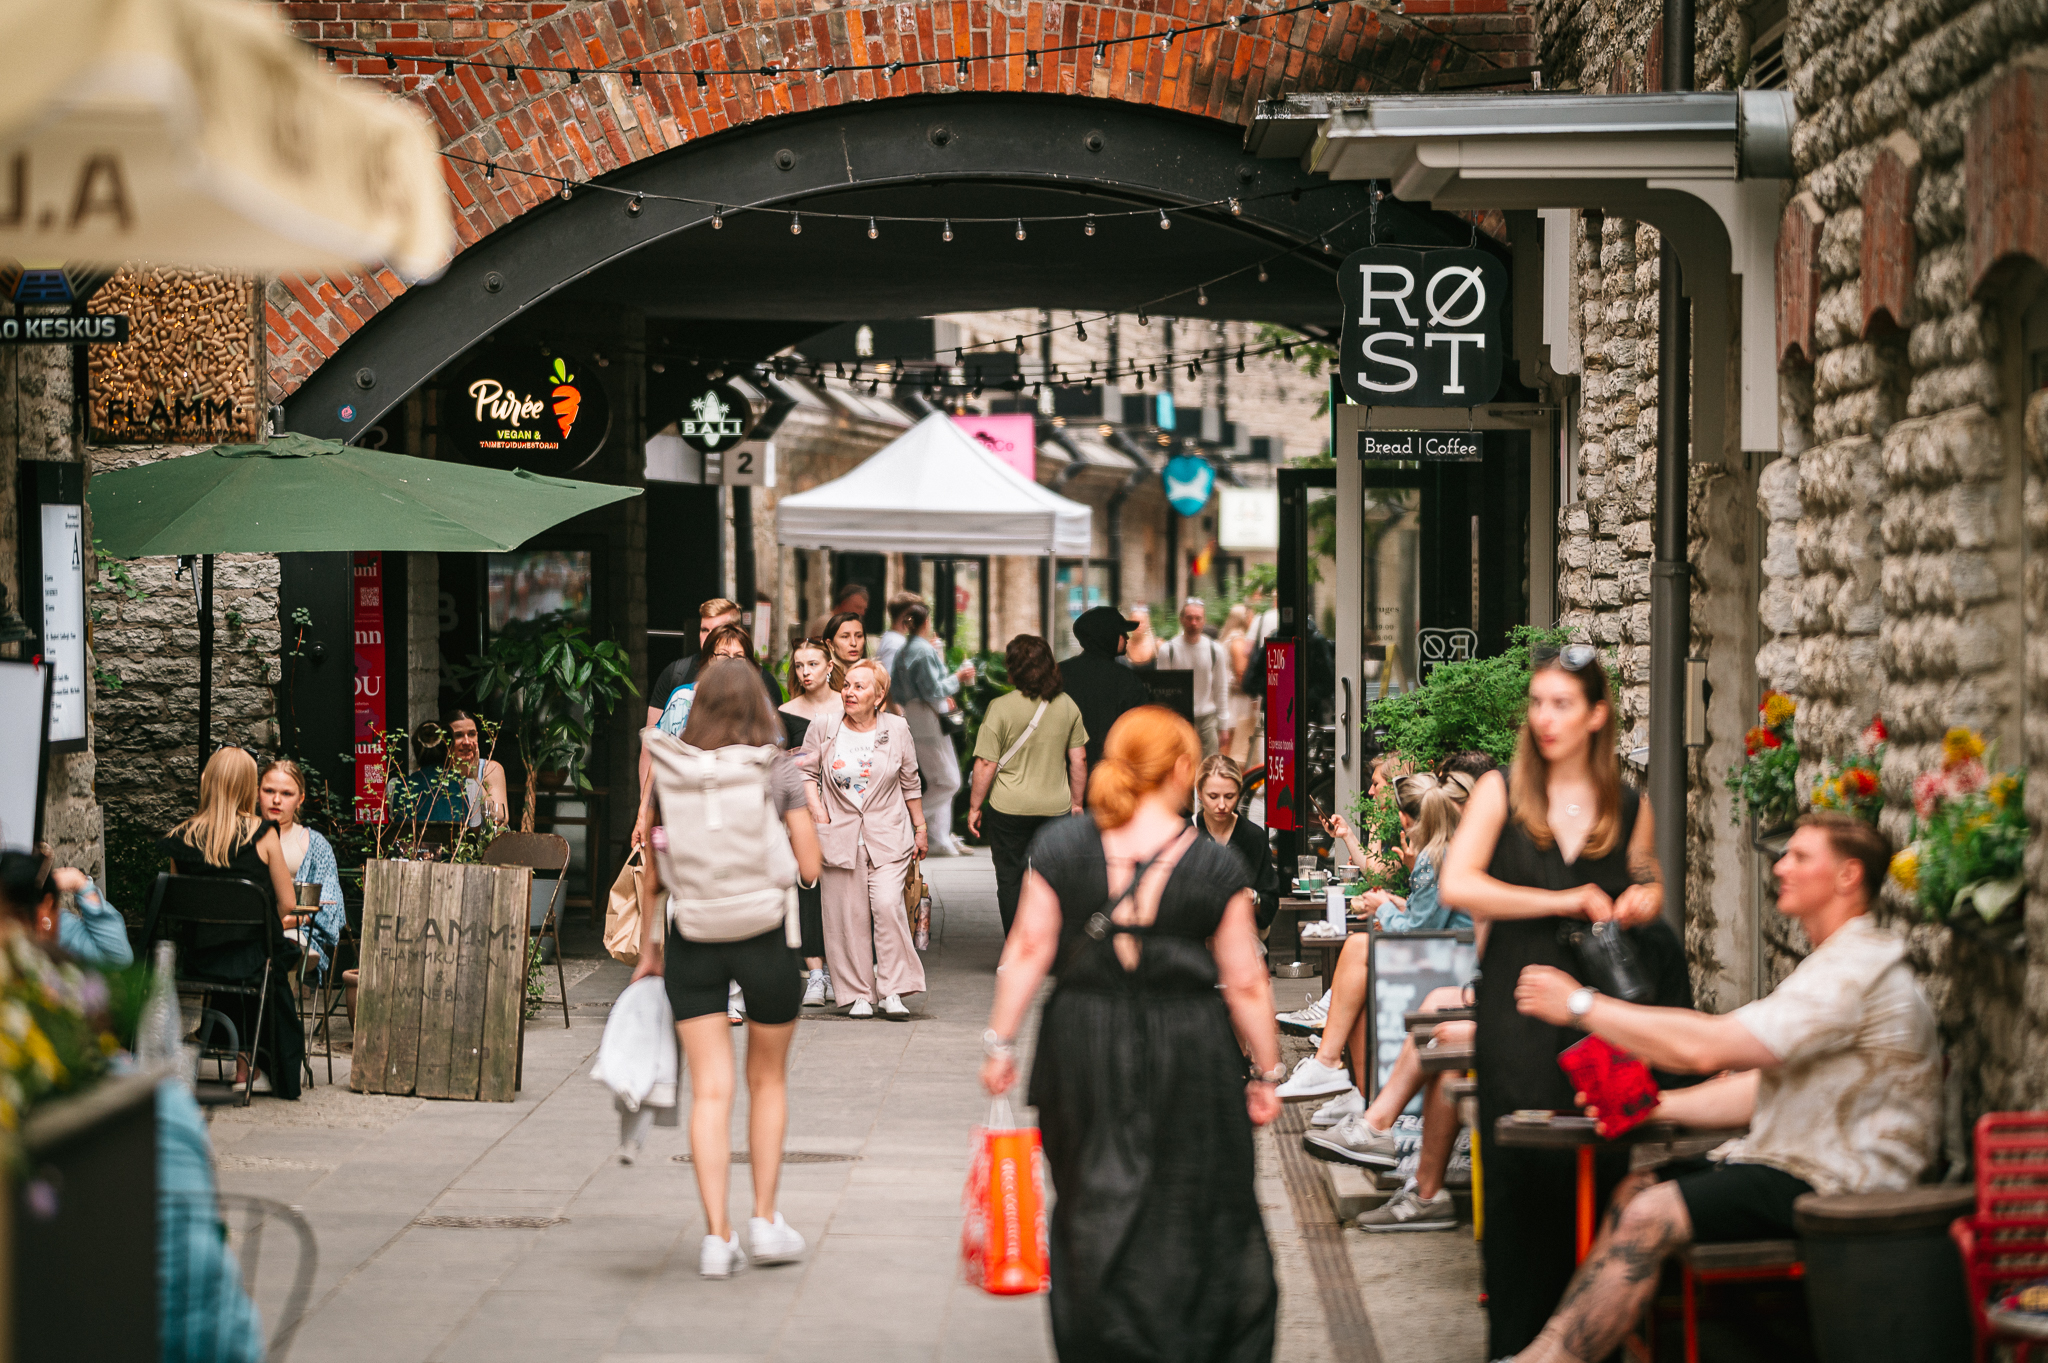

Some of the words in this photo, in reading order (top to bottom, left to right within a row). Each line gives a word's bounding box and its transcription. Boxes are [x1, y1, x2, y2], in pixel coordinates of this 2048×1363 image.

[1359, 264, 1486, 327] RØ
[0, 318, 19, 338] O
[26, 317, 116, 338] KESKUS
[1358, 331, 1485, 394] ST
[468, 379, 544, 427] Purée
[497, 430, 532, 440] VEGAN
[534, 431, 542, 441] &
[683, 421, 741, 434] BALI
[1365, 437, 1412, 455] Bread
[1426, 438, 1477, 456] Coffee
[737, 452, 754, 475] 2
[1268, 755, 1285, 786] 3,5€
[397, 986, 441, 1002] WINE
